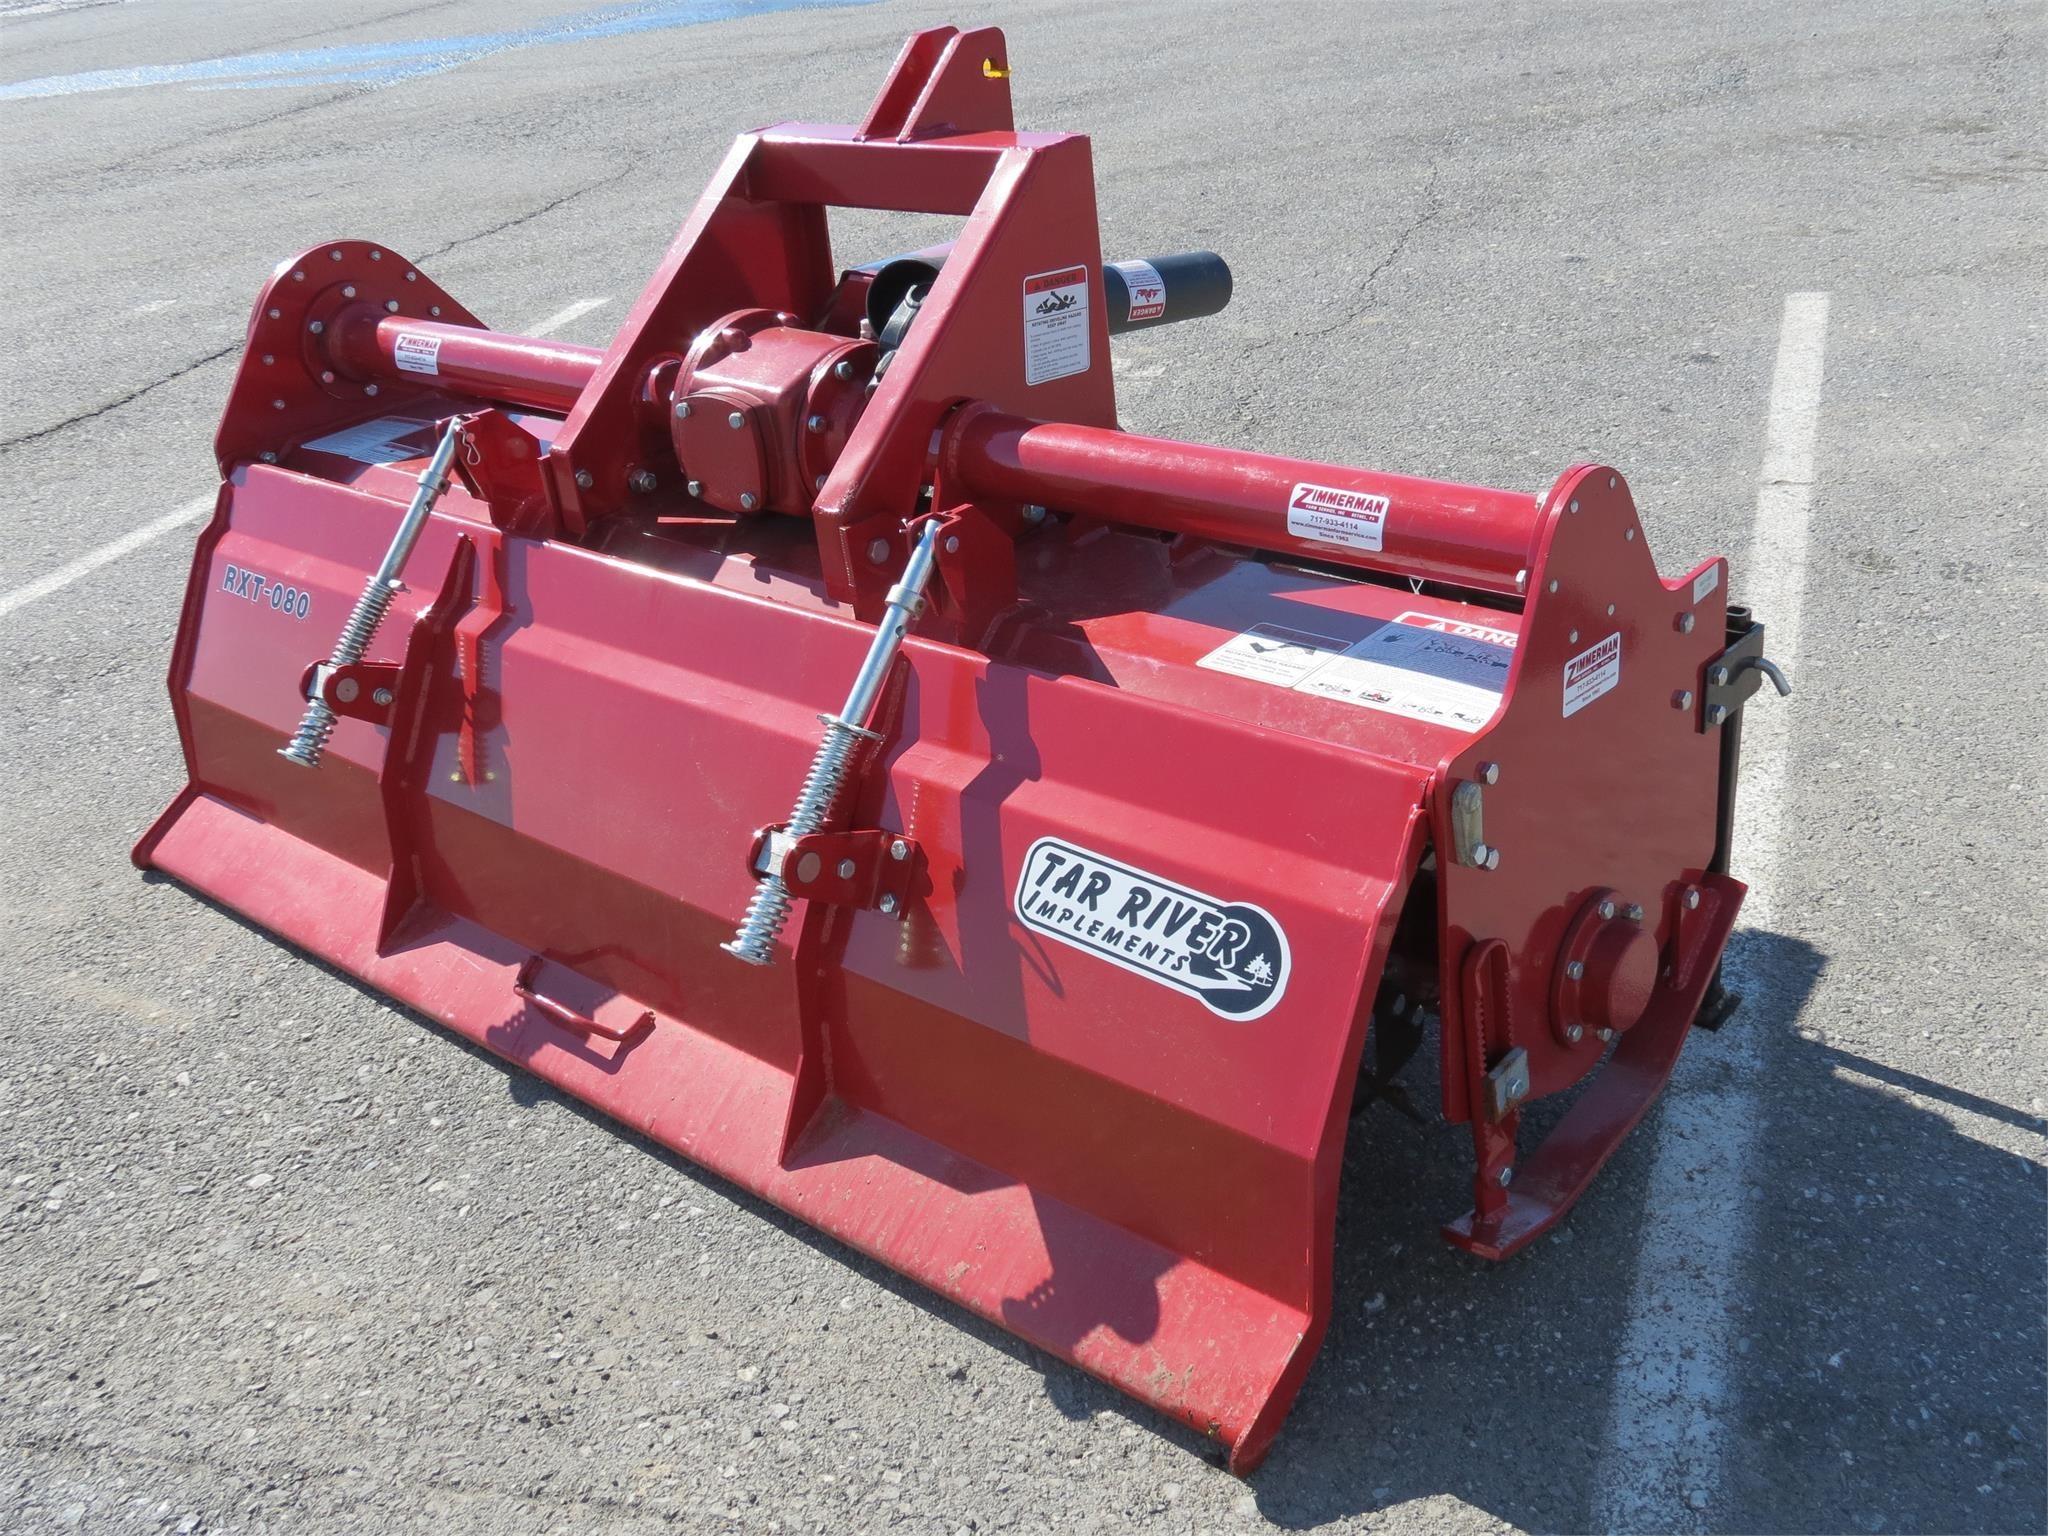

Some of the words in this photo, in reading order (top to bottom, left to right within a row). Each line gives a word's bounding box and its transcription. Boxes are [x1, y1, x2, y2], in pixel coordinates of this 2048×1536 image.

[1292, 487, 1385, 514] ZIMMERMAN
[1310, 515, 1359, 530] 717-933-4114
[222, 564, 310, 619] RXT-080
[1453, 626, 1518, 647] DANG
[1566, 636, 1618, 689] ZIMMERMAN
[1024, 890, 1190, 971] IMPLEMENTS
[1035, 852, 1111, 911] TAR
[1116, 886, 1250, 969] RIVER
